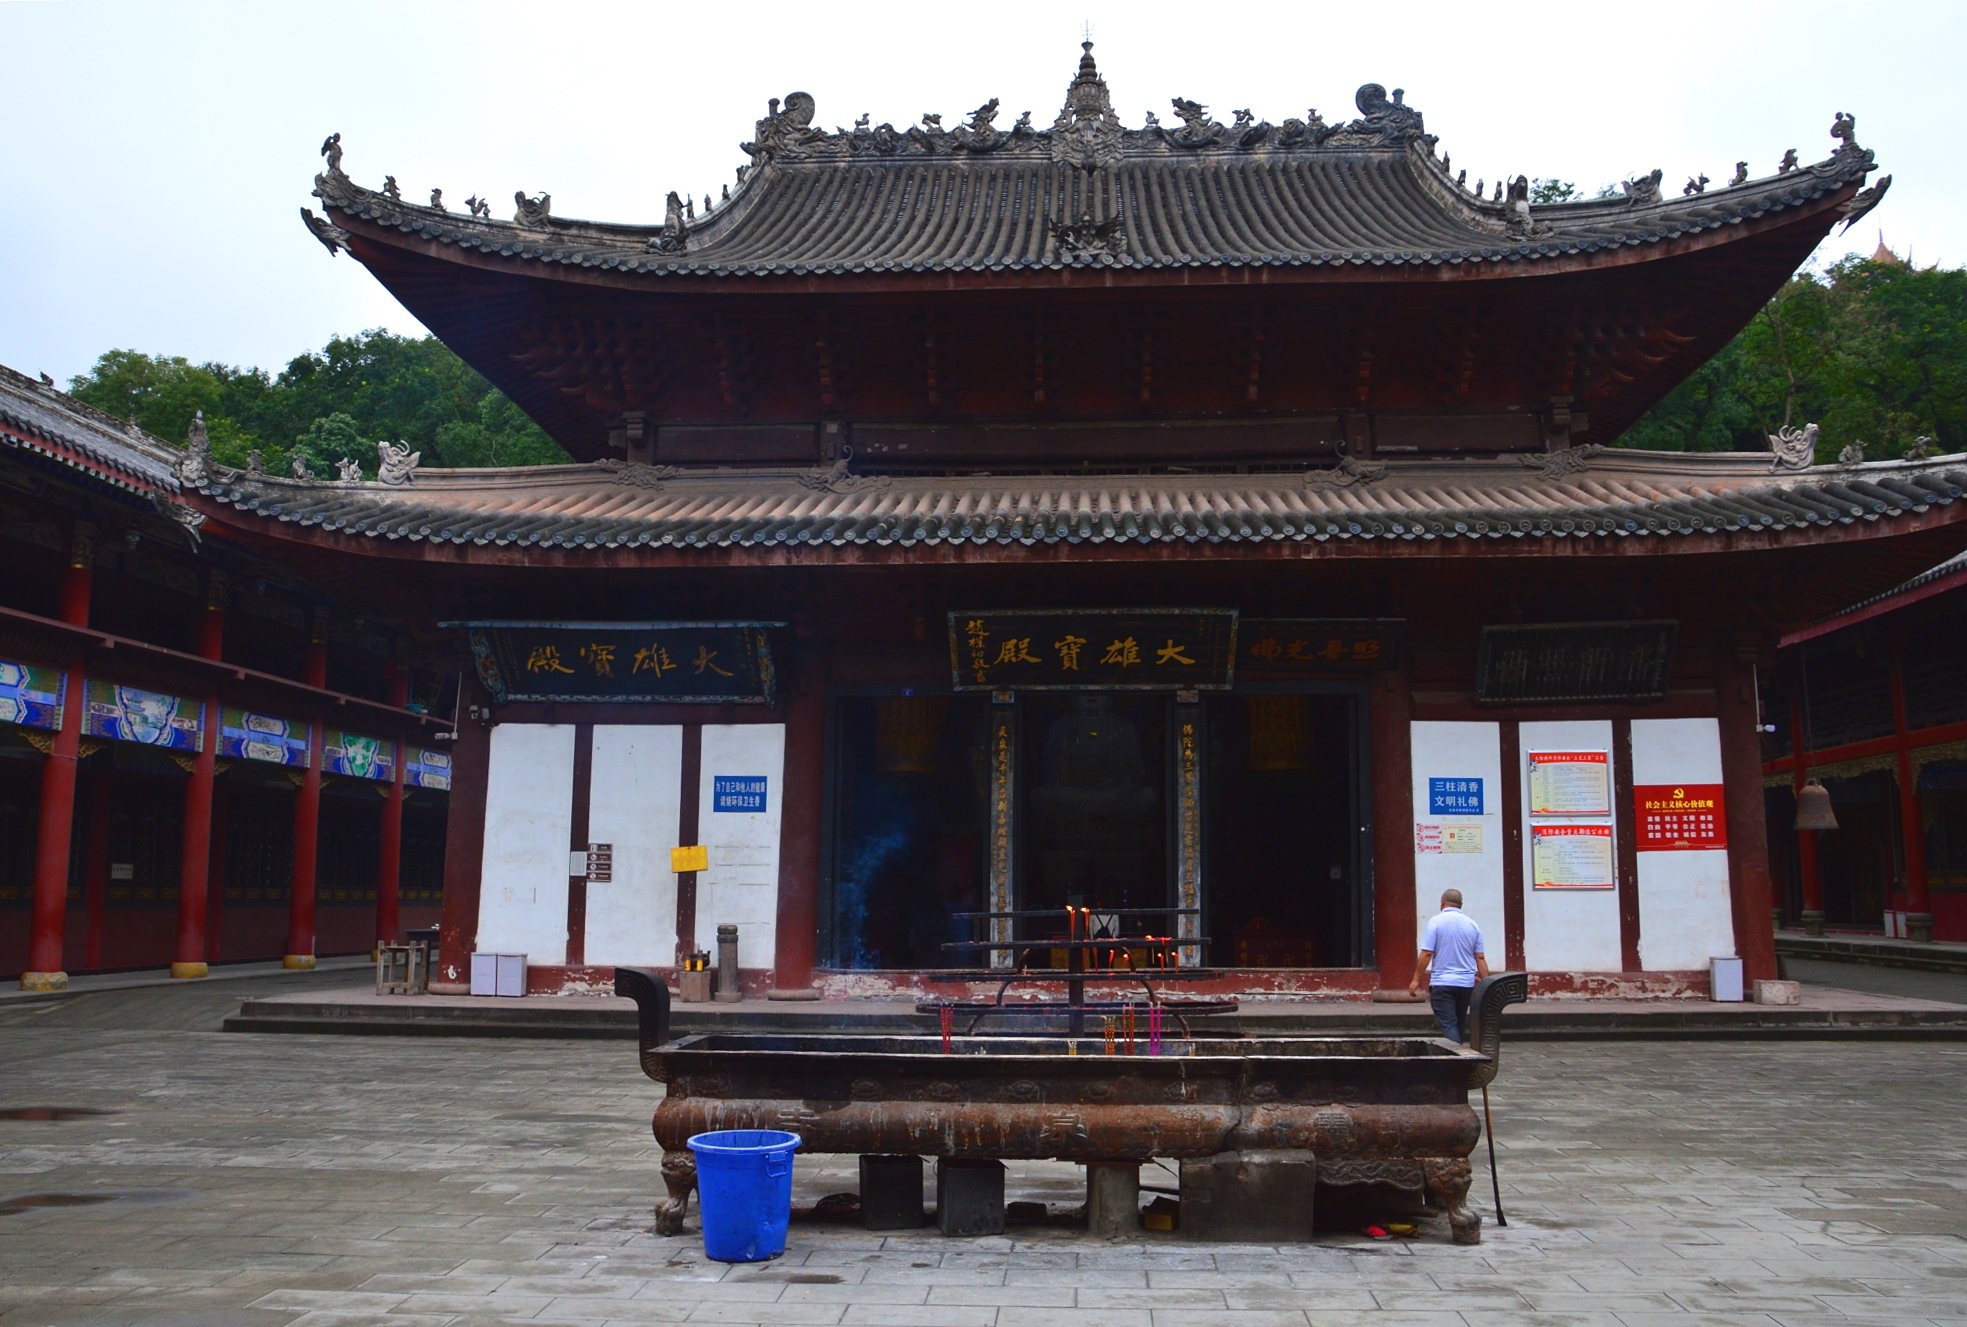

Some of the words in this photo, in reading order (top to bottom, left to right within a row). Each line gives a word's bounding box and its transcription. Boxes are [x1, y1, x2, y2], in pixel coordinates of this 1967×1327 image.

[993, 635, 1197, 671] 大雄寶殿
[1249, 637, 1380, 661] 佛光普照
[1434, 781, 1479, 792] 三柱清香
[1434, 796, 1479, 807] 文明礼佛
[1645, 800, 1714, 809] 社会主义核心价值观
[1039, 1109, 1088, 1148] 泉
